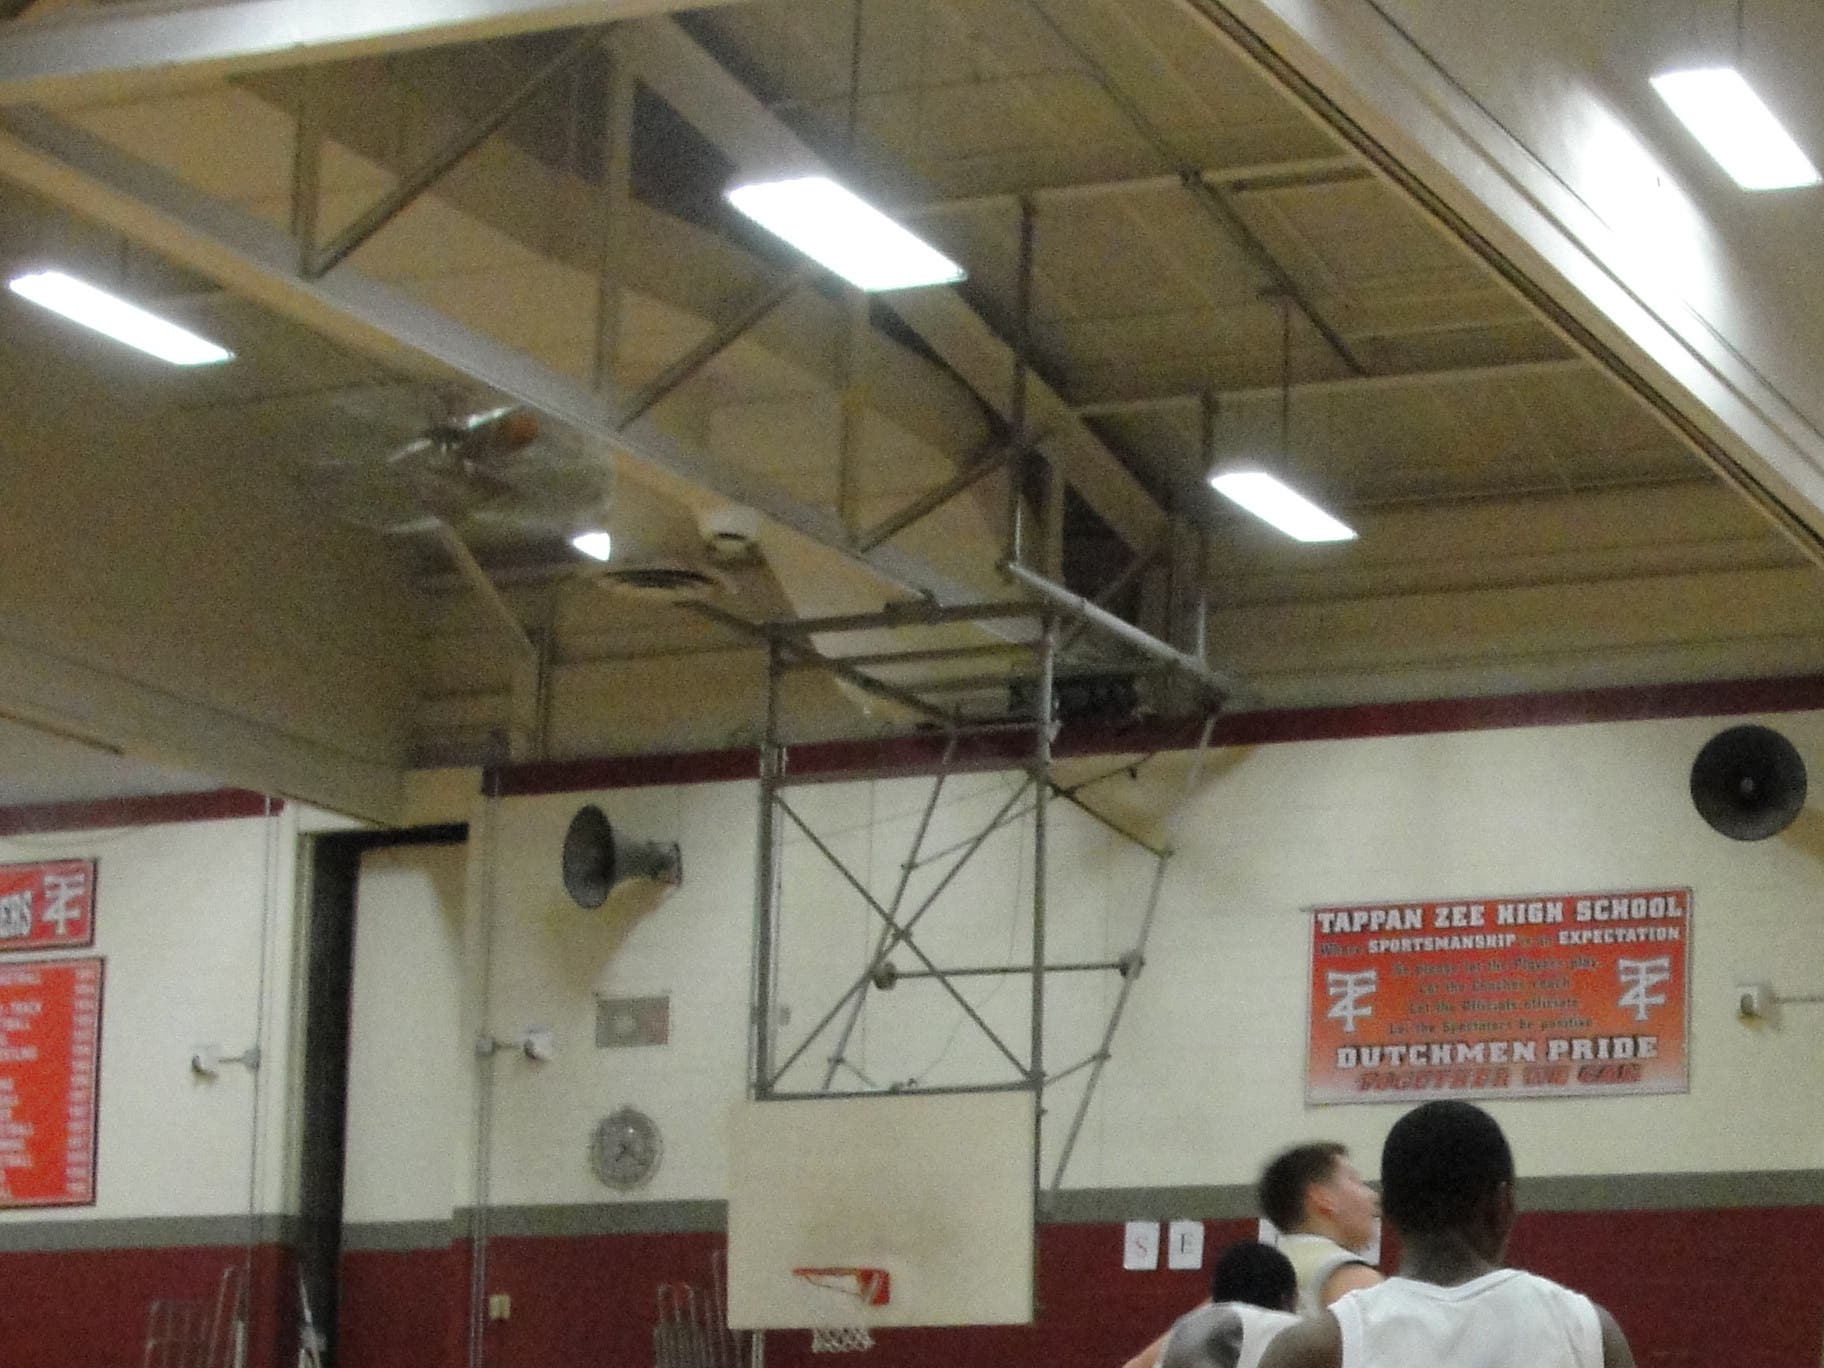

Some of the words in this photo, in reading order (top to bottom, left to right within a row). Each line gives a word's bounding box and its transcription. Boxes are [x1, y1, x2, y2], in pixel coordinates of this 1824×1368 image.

[1317, 908, 1424, 934] TAPPAN
[1434, 904, 1486, 929] ZEE
[1497, 901, 1564, 926] HIGH
[1575, 896, 1683, 922] SCHOOL
[1368, 933, 1517, 955] SPORTSMANSHIP
[1558, 926, 1680, 946] EXPECTATION
[1336, 1039, 1538, 1070] DUTCHMEN
[1548, 1036, 1659, 1063] PRIDE
